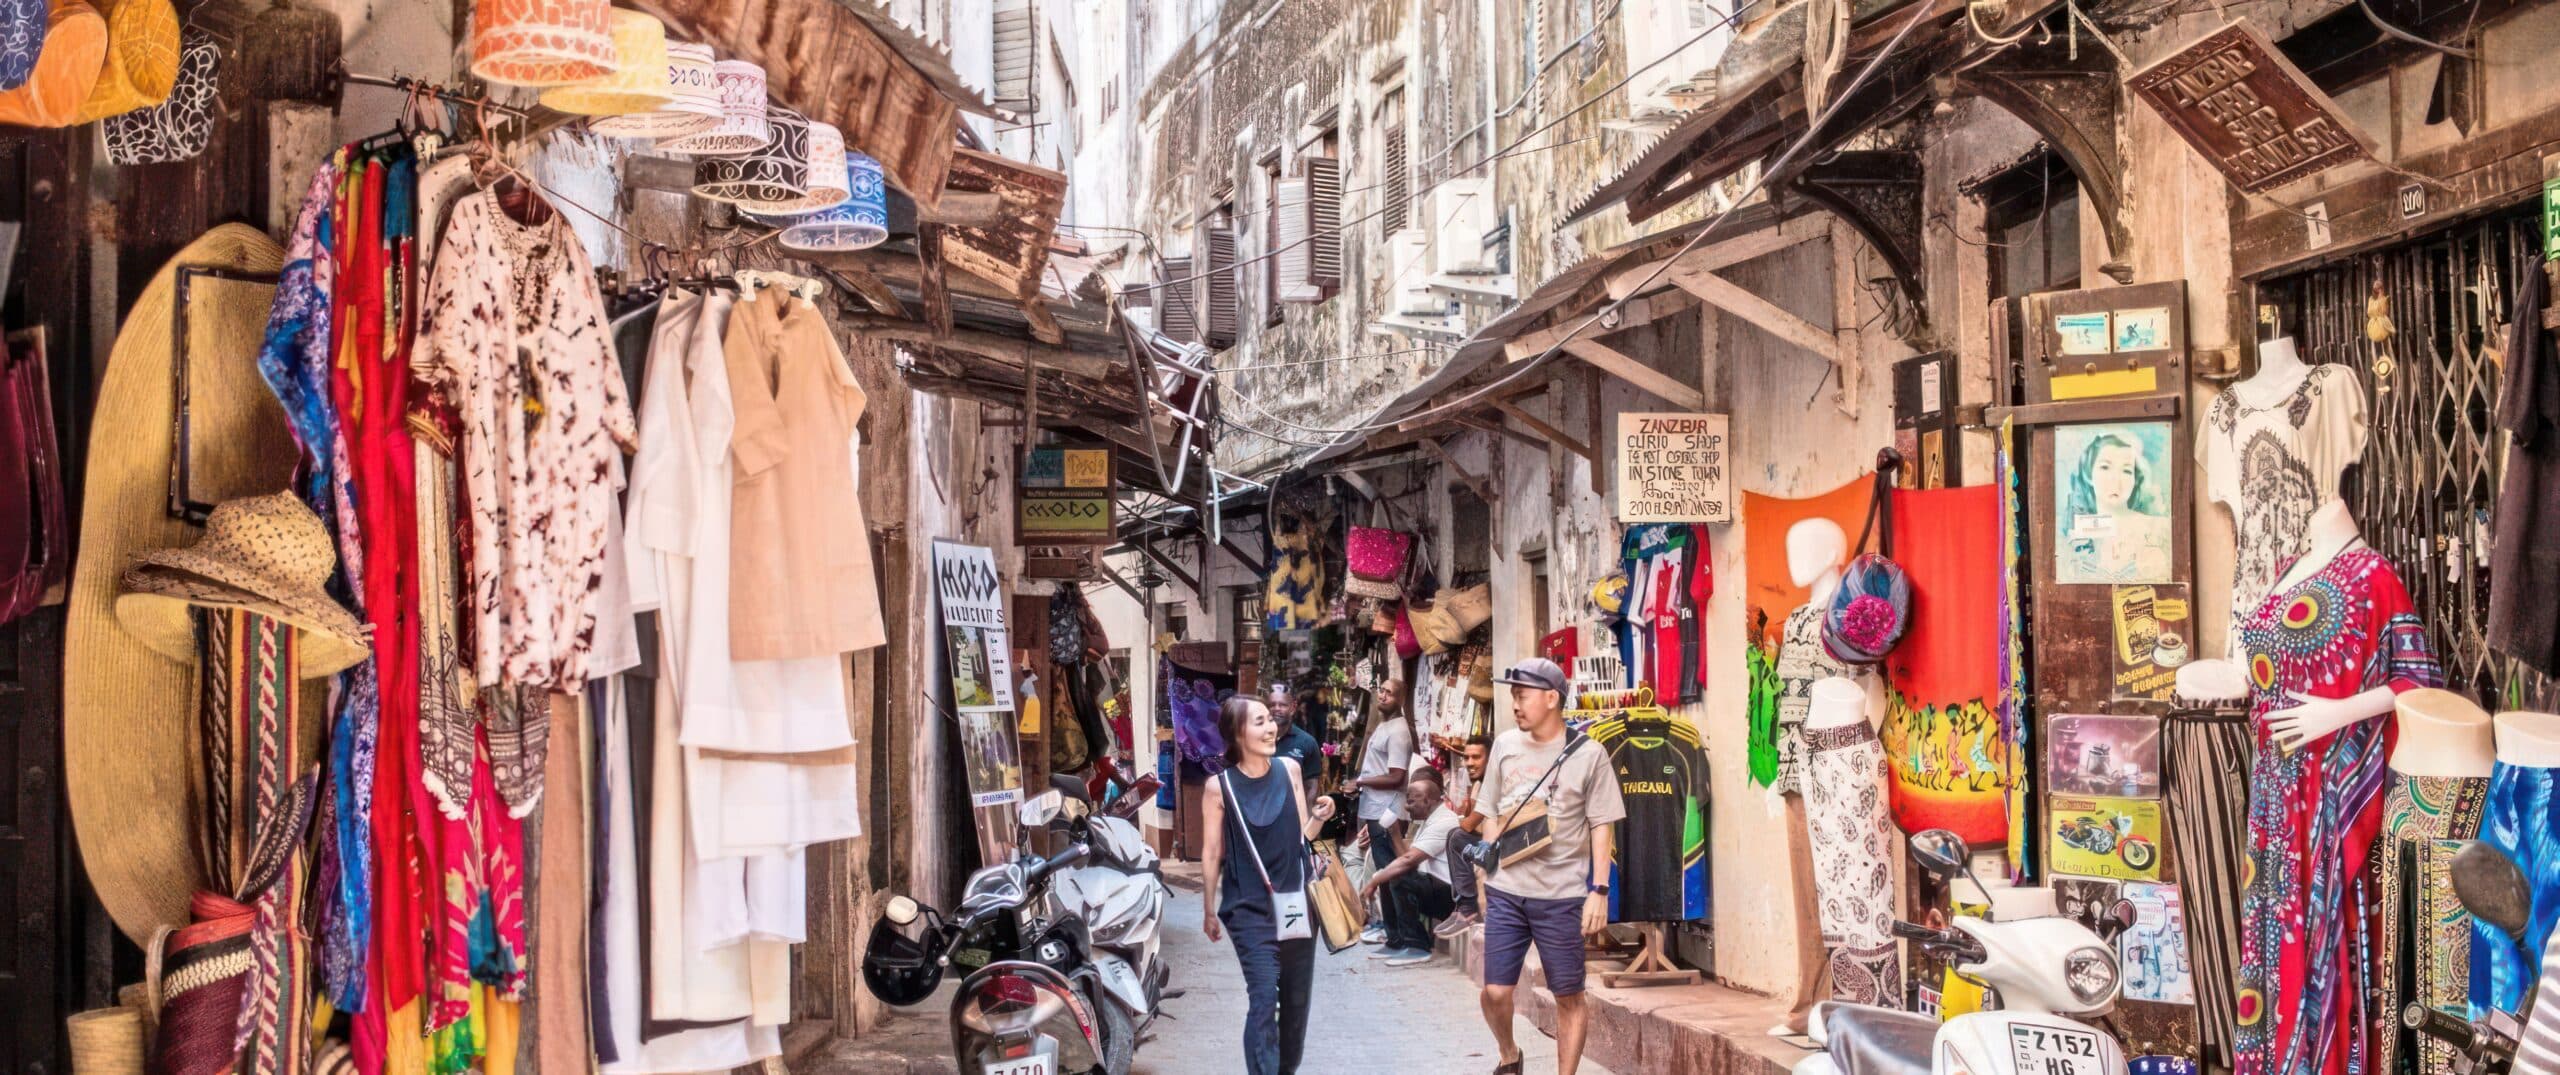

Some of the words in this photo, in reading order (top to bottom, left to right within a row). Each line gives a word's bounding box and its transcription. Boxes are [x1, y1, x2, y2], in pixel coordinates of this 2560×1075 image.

[1627, 434, 1669, 449] CURIO
[1628, 465, 1644, 481] IN
[2051, 1033, 2096, 1058] 152
[2044, 1056, 2076, 1075] HG
